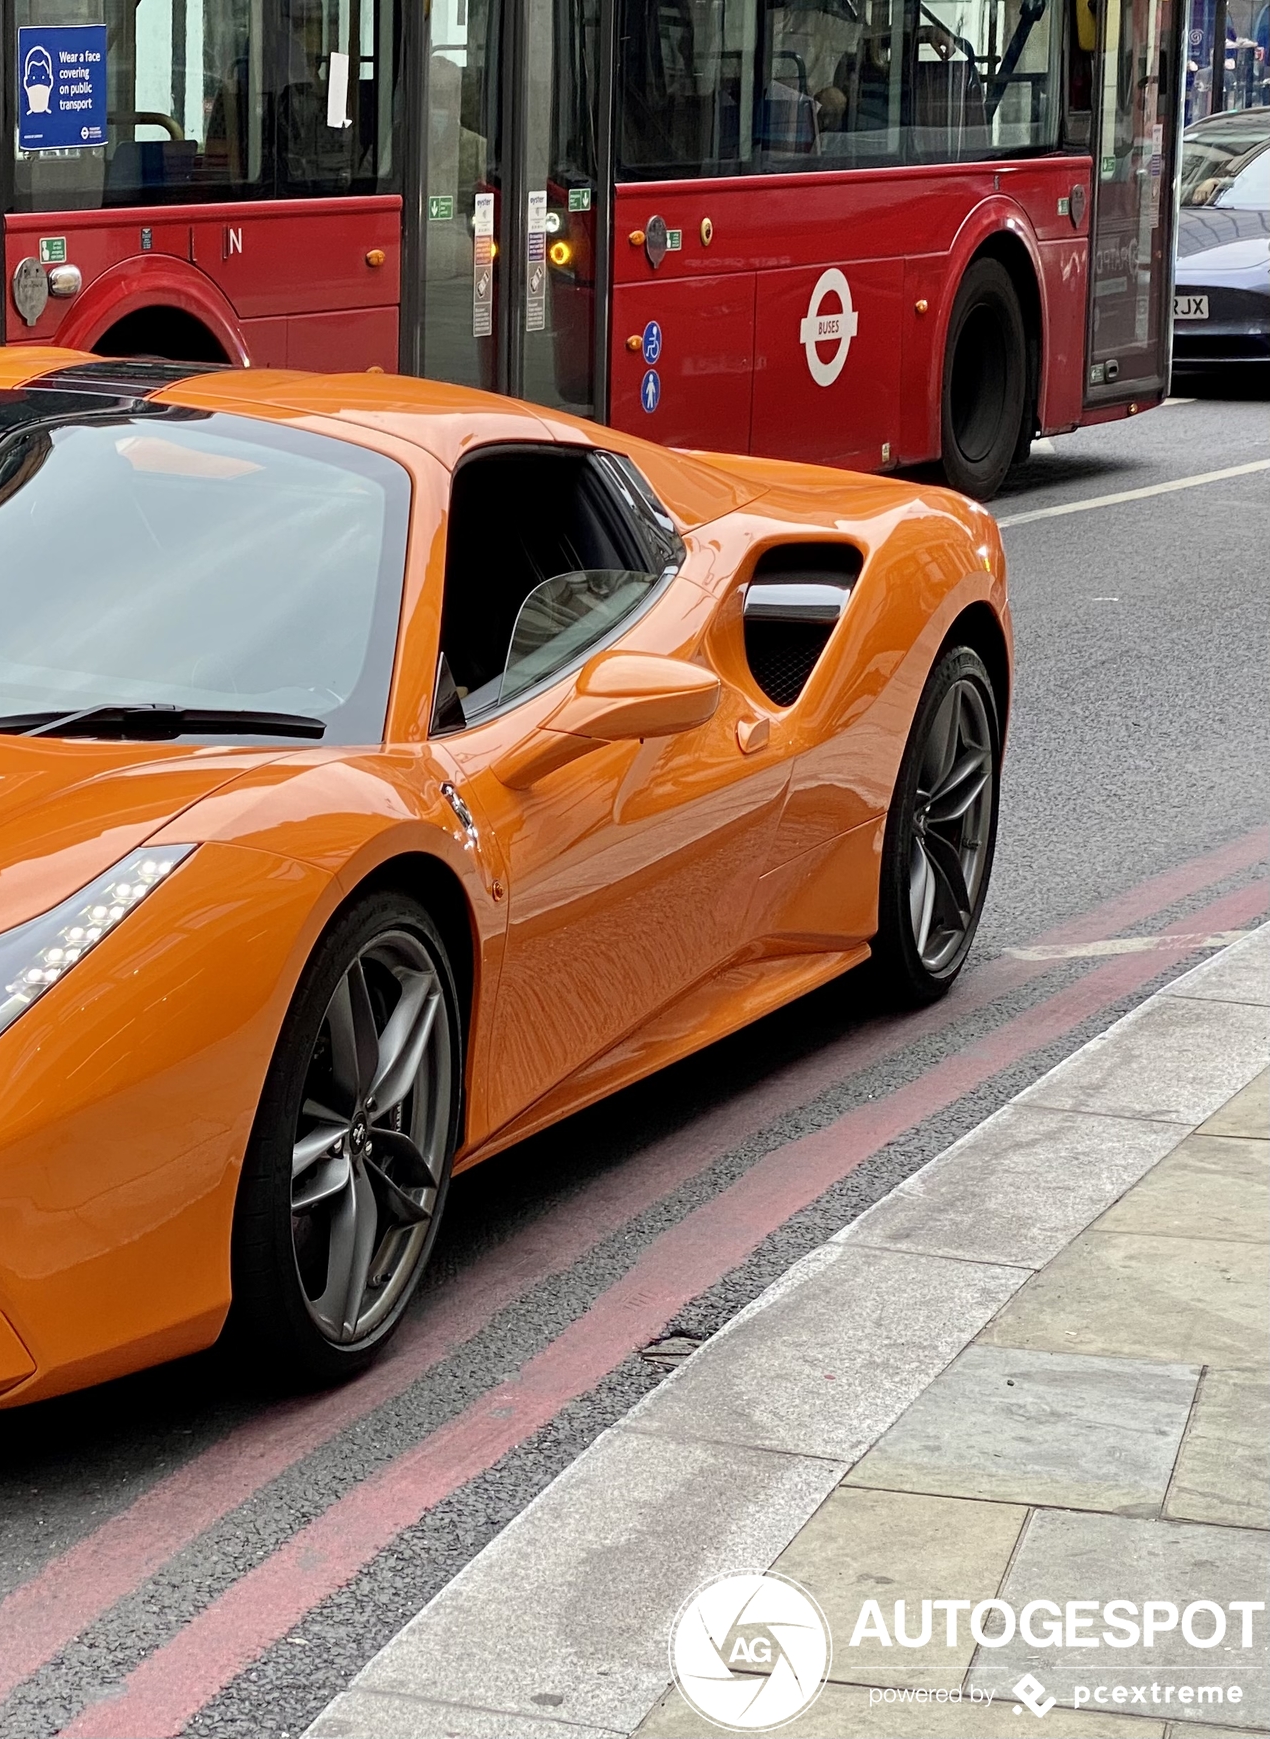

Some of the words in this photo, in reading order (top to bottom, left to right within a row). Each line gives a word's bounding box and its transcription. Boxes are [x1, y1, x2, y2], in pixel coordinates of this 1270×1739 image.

[59, 51, 78, 63] Wear
[79, 54, 84, 62] a
[85, 50, 101, 62] face
[59, 67, 90, 80] covering
[59, 86, 69, 95] on
[70, 83, 92, 96] public
[59, 99, 92, 112] transport
[230, 228, 242, 254] N
[818, 320, 840, 335] BUSES
